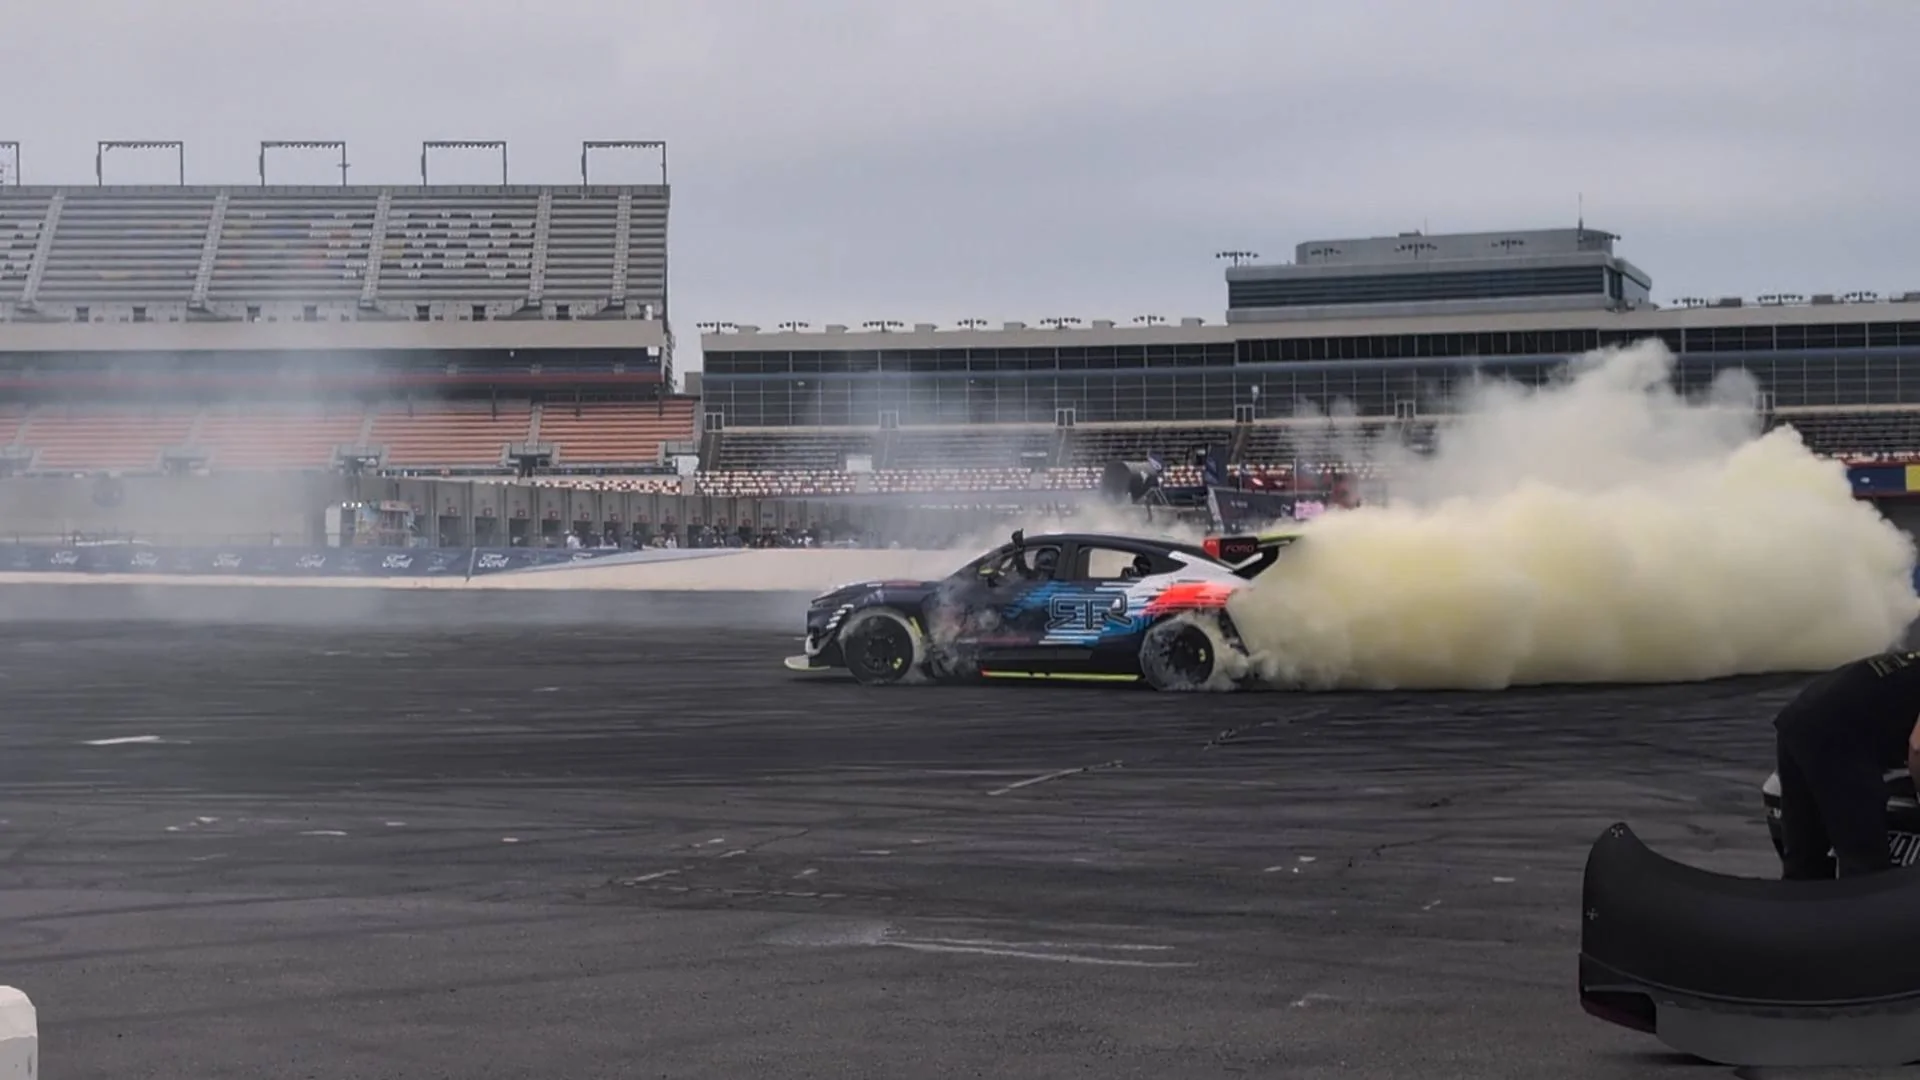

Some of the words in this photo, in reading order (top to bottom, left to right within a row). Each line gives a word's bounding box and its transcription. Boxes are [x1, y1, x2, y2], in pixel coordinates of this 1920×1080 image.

[1224, 543, 1254, 553] FORD
[382, 553, 413, 568] Ford
[478, 553, 510, 568] Ford
